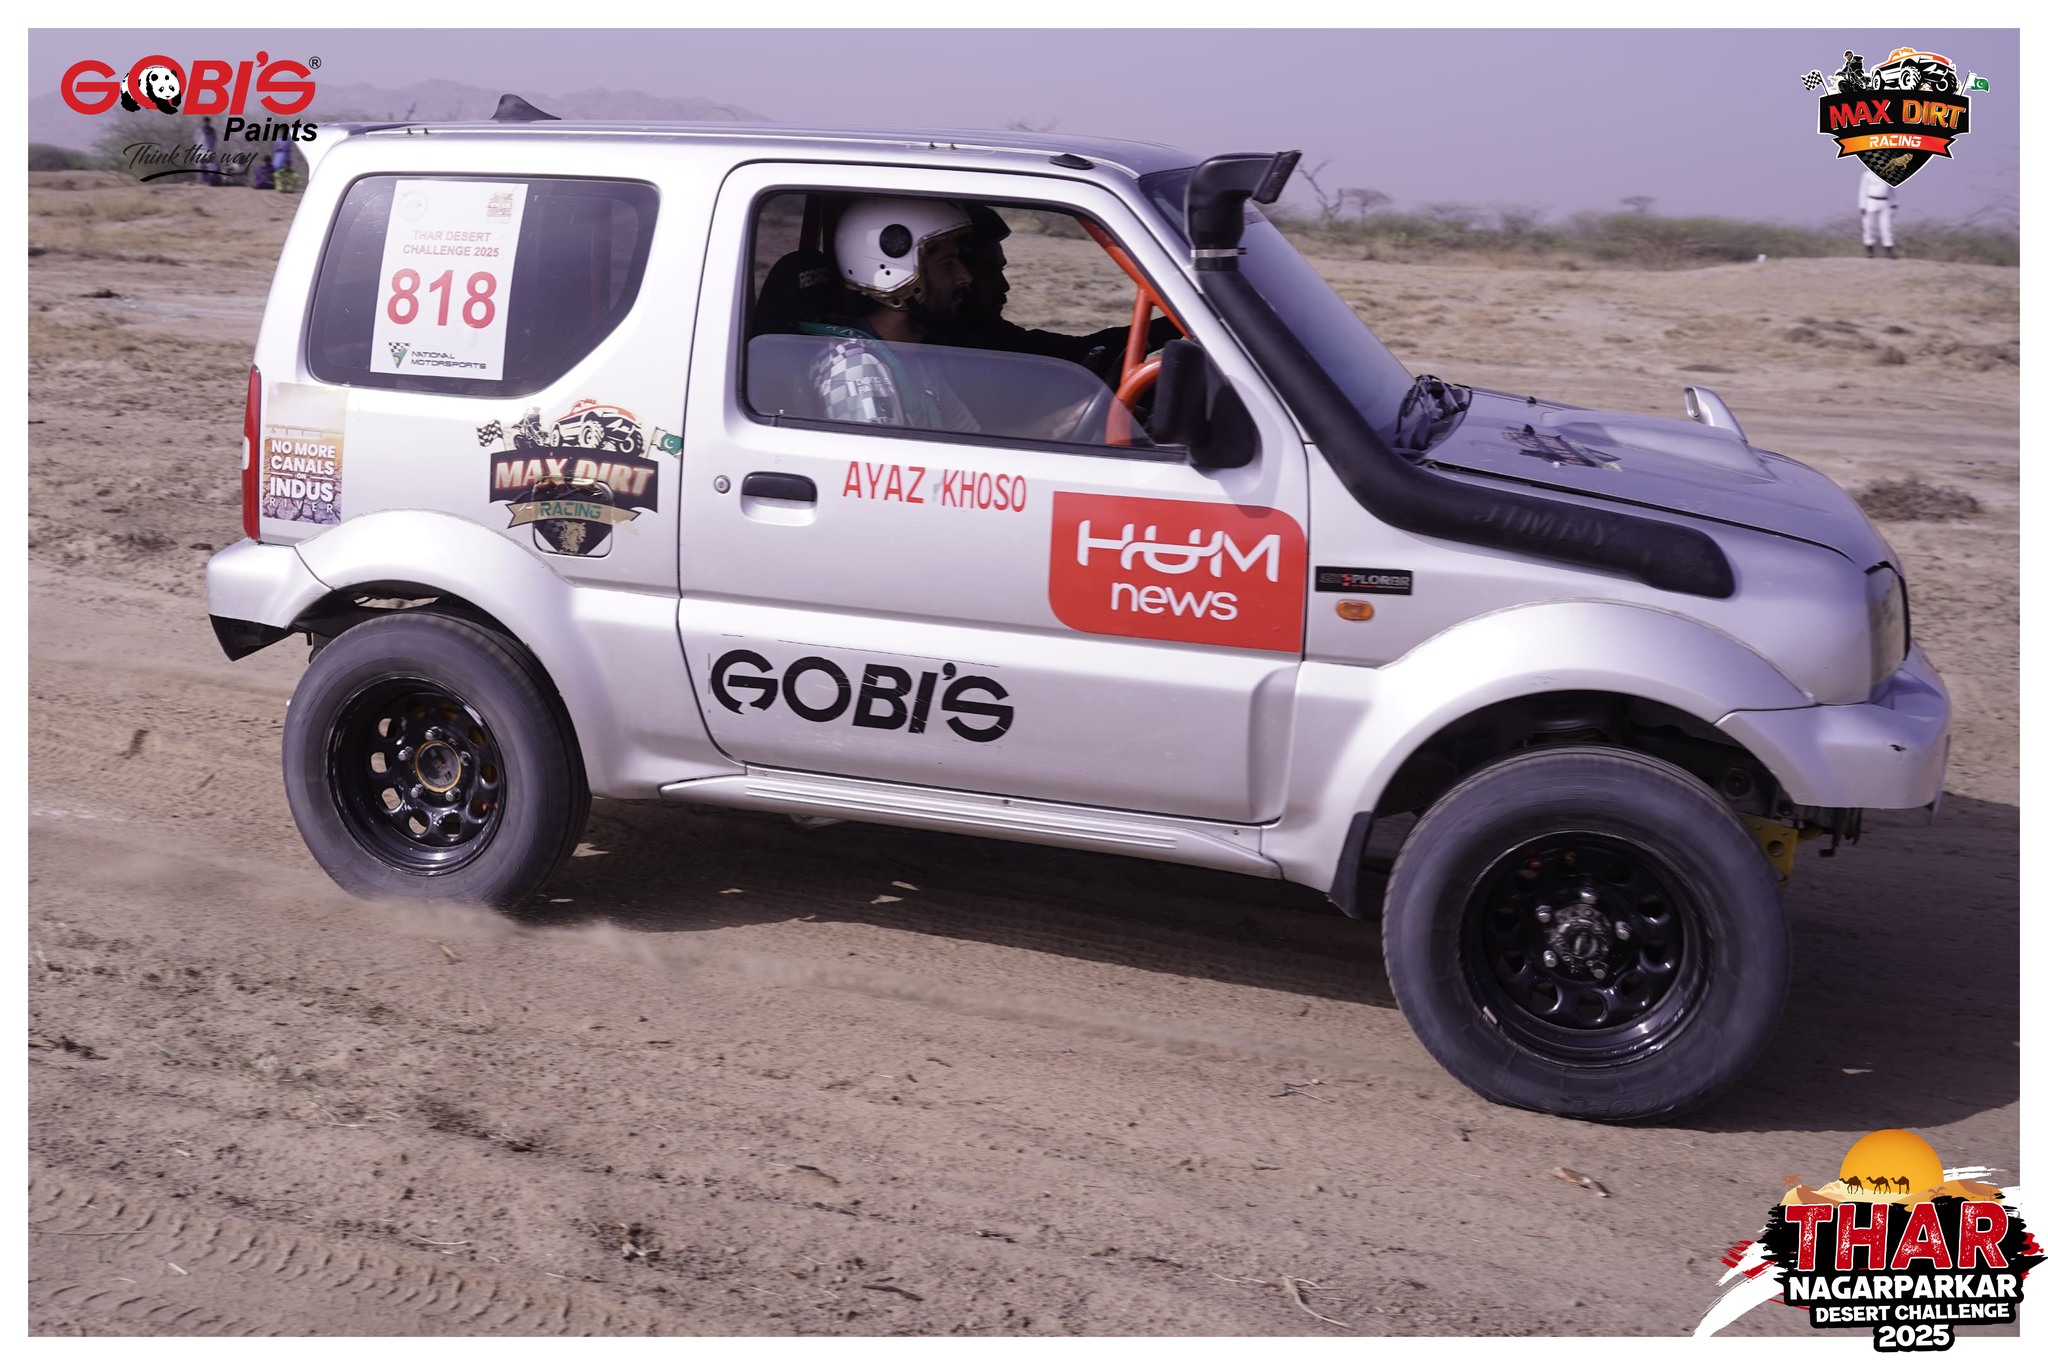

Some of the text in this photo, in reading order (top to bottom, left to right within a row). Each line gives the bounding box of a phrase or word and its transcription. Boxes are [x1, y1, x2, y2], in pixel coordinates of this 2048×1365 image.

[413, 230, 492, 242] THAR DESERT
[403, 244, 500, 258] CHALLENGE 2025
[387, 267, 497, 329] 818
[411, 351, 455, 360] NATIONAL
[411, 359, 487, 370] MOTORSPORTS
[271, 439, 336, 459] NO MORE
[270, 455, 336, 476] CANALS
[296, 472, 307, 480] ON
[494, 457, 655, 495] MAX DIRT
[269, 477, 335, 503] INDUS
[842, 460, 1027, 513] AYAZ KHOSO
[269, 497, 334, 514] RIVER
[540, 502, 603, 519] RACING
[1076, 520, 1281, 583] HUM
[1111, 582, 1239, 622] news
[710, 649, 1015, 743] GOBI'S
